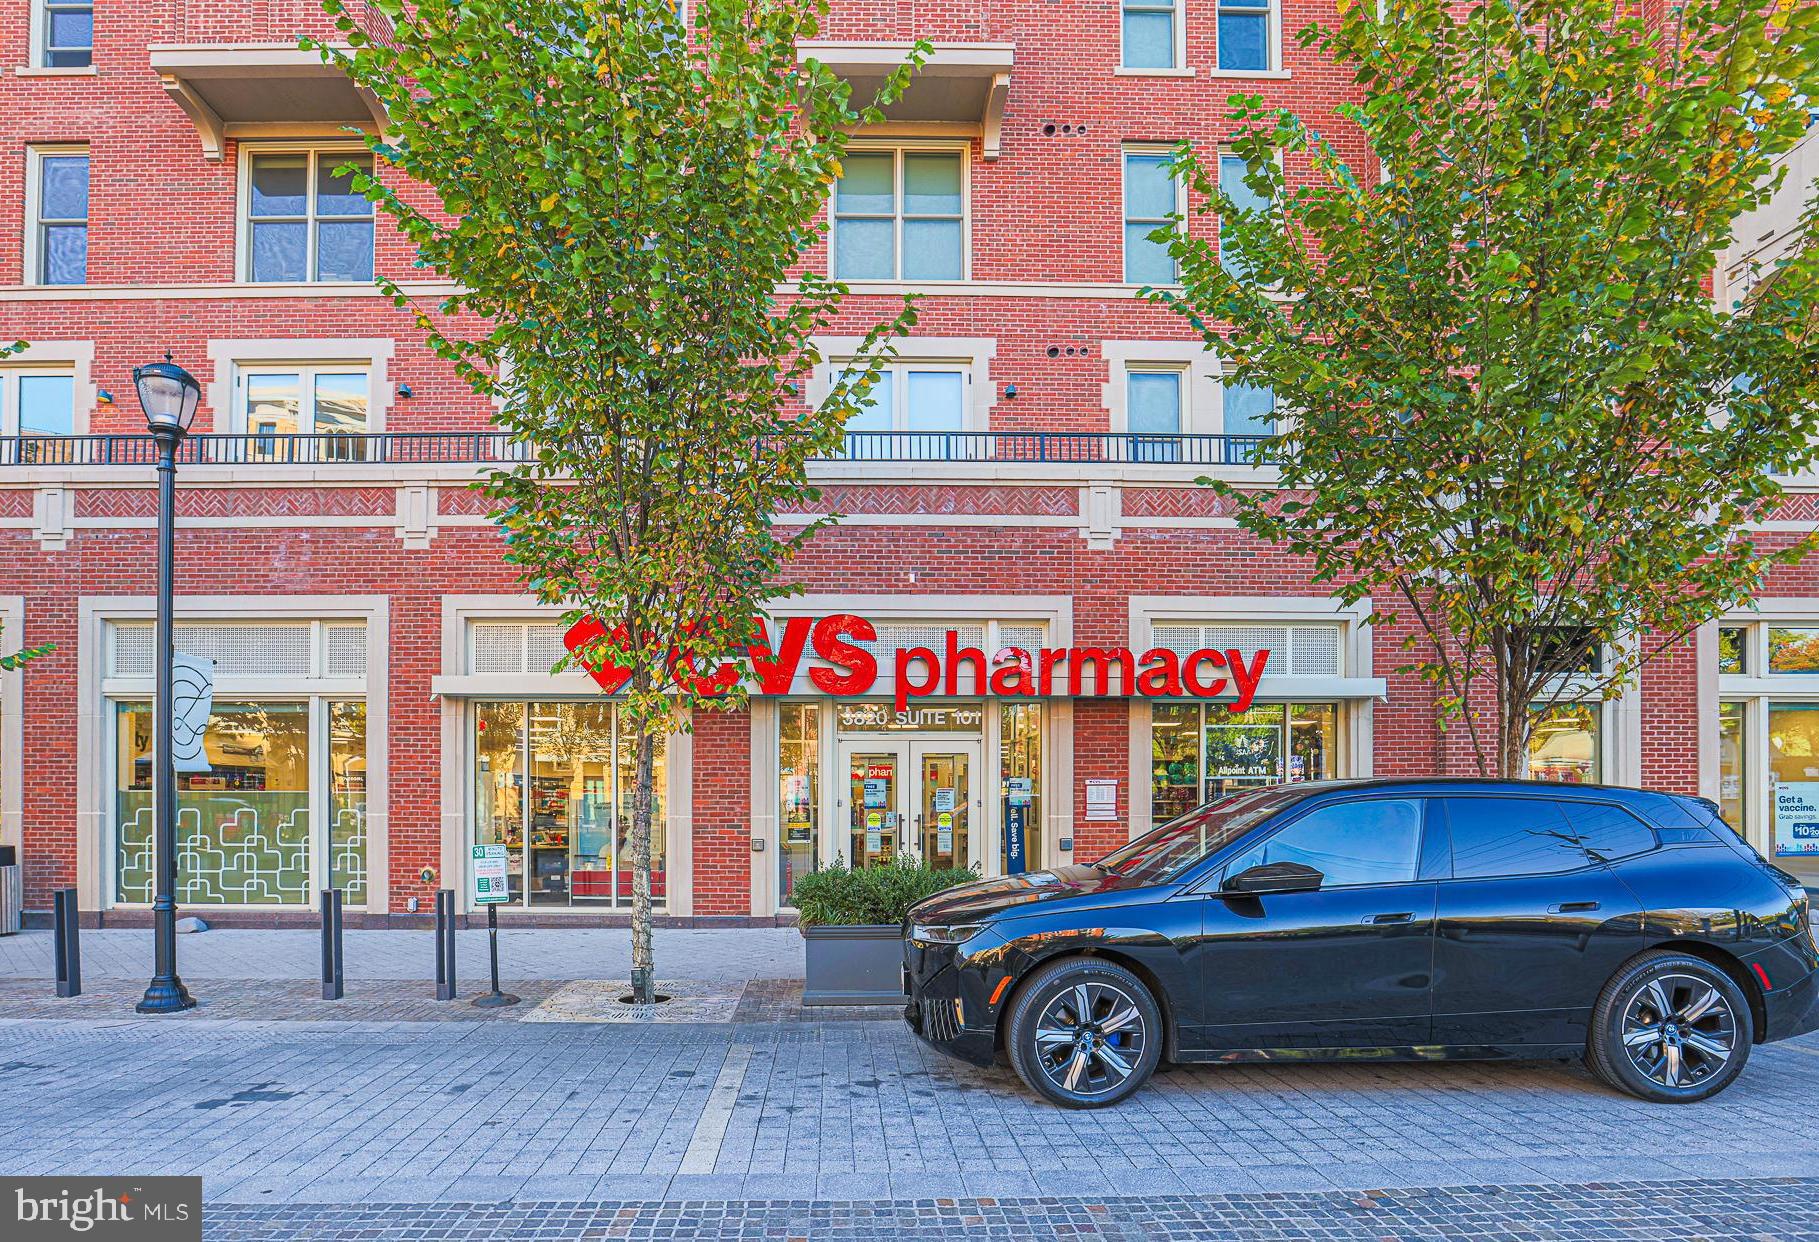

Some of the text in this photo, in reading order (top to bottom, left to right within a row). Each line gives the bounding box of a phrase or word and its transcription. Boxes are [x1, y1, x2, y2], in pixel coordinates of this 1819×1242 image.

[667, 614, 1271, 713] CVS pharmacy
[842, 710, 981, 725] 3820 SUITE 101
[1218, 764, 1245, 775] Allpoint
[1011, 822, 1019, 843] Save
[474, 847, 484, 857] 30
